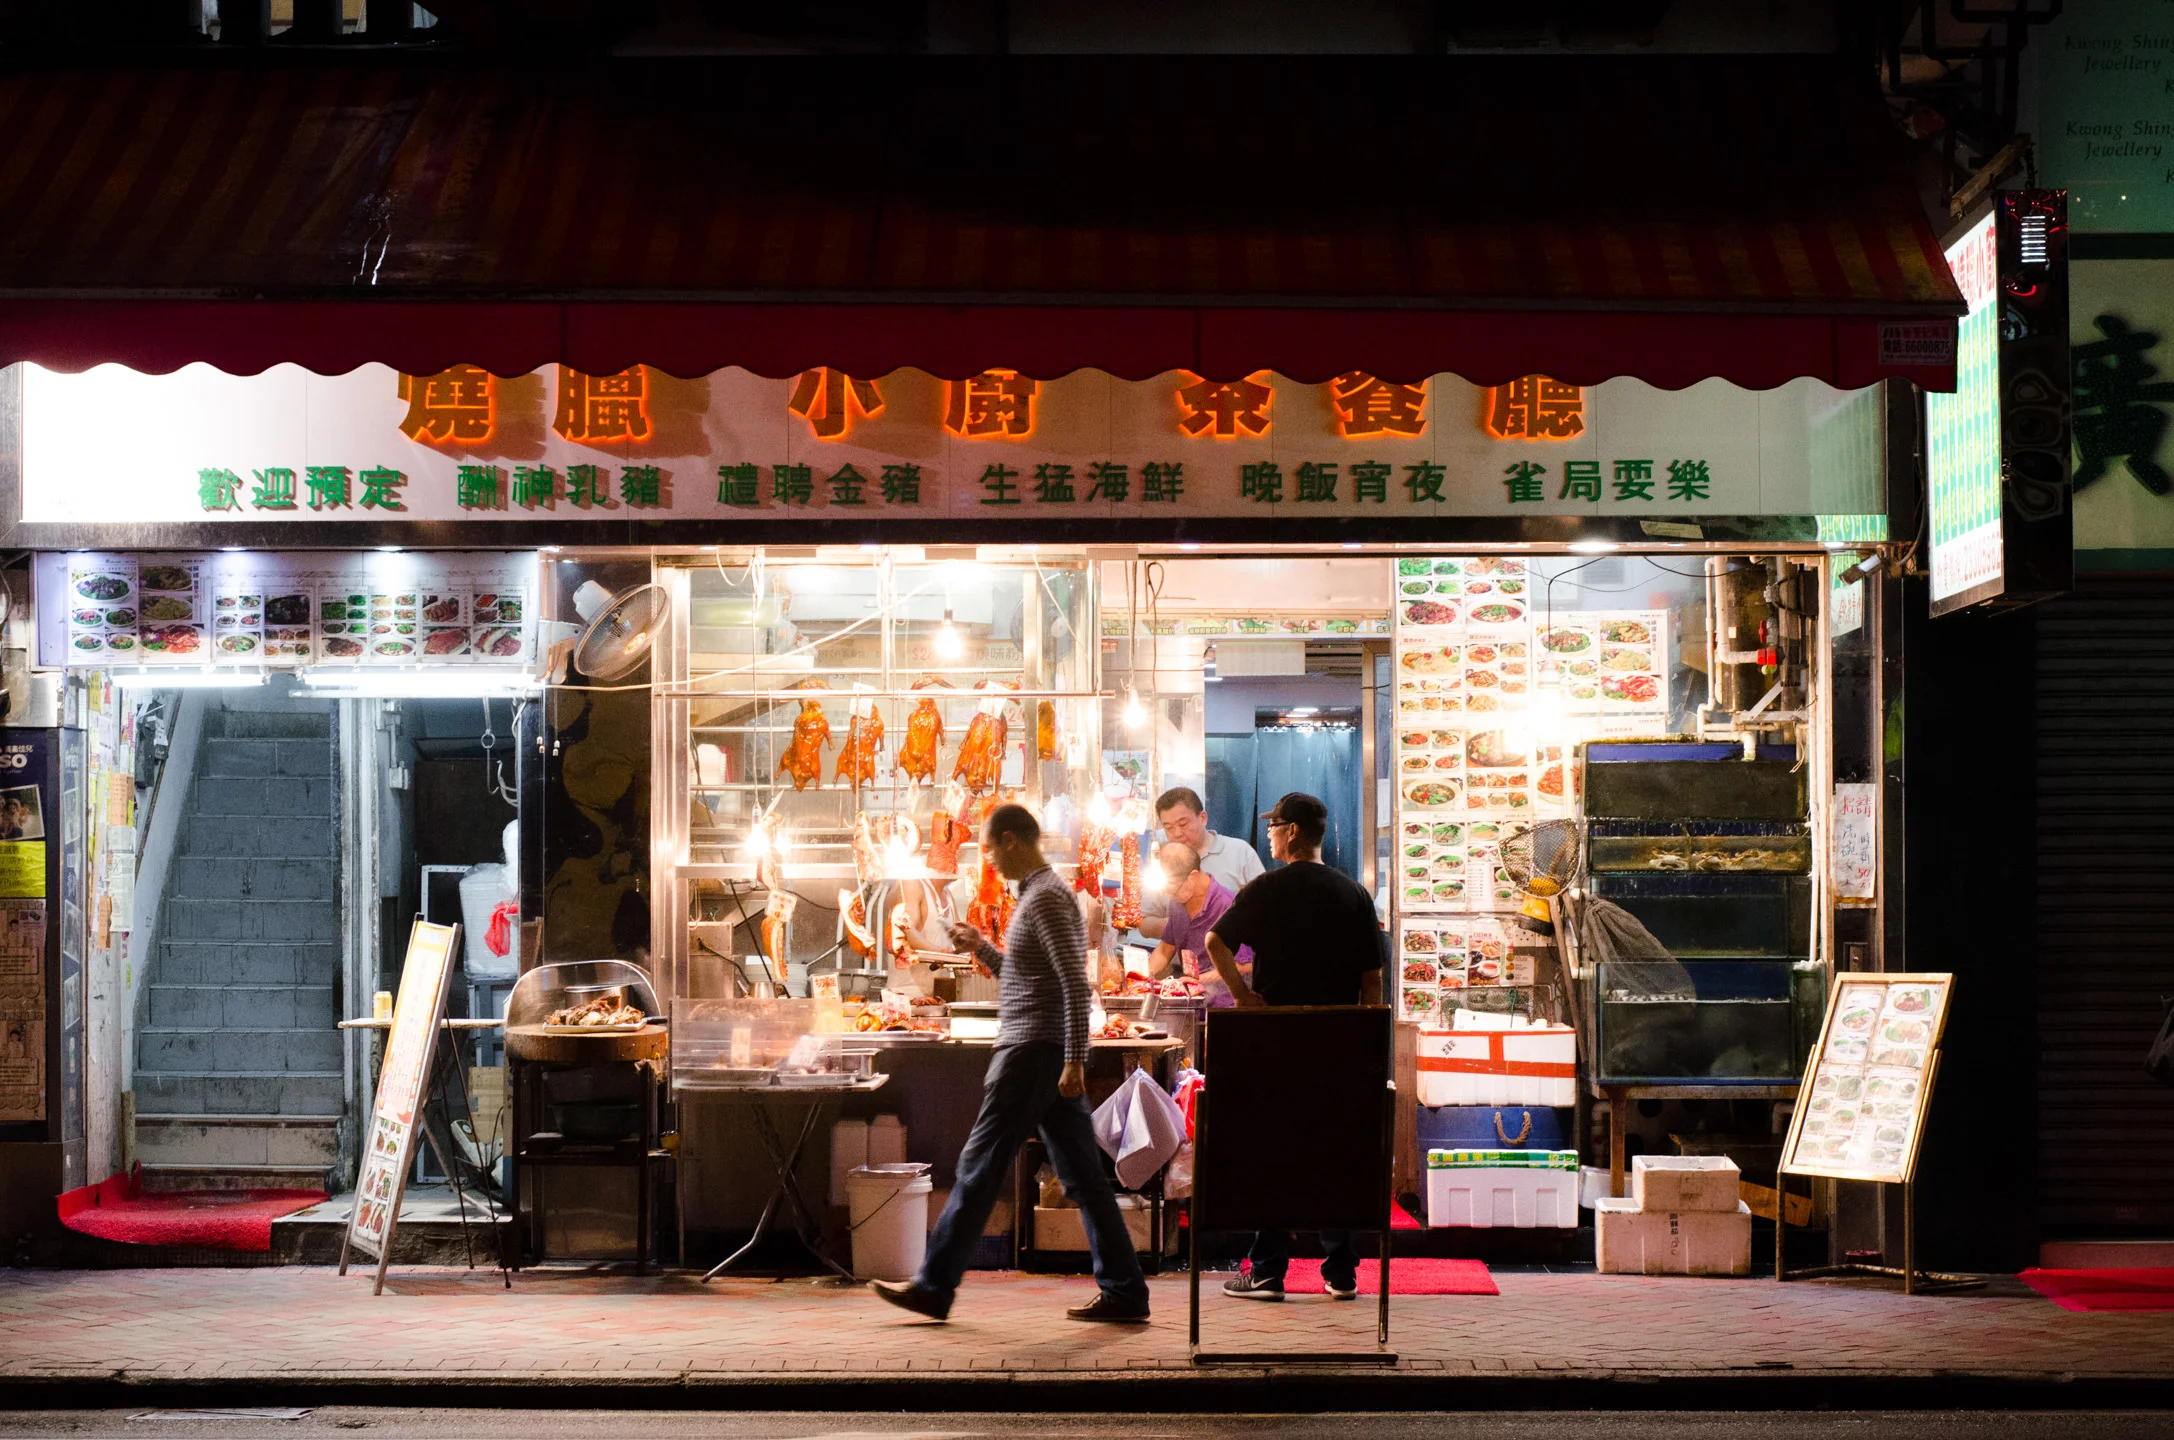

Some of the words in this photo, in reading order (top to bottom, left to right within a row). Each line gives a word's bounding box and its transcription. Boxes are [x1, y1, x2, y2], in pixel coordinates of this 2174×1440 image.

[2065, 35, 2123, 53] Kwong
[2084, 55, 2162, 75] Jewellery
[2066, 120, 2124, 140] Kwong
[2085, 142, 2163, 161] Jewellery
[1904, 340, 1950, 354] 66000875
[1176, 369, 1585, 441] 茶餐廳
[197, 464, 401, 508] 歡迎預定
[456, 463, 661, 506] 酬神乳豬
[717, 462, 921, 505] 禮聘金豬
[978, 461, 1185, 504] 生猛海鮮
[1240, 460, 1448, 503] 晚飯宵夜
